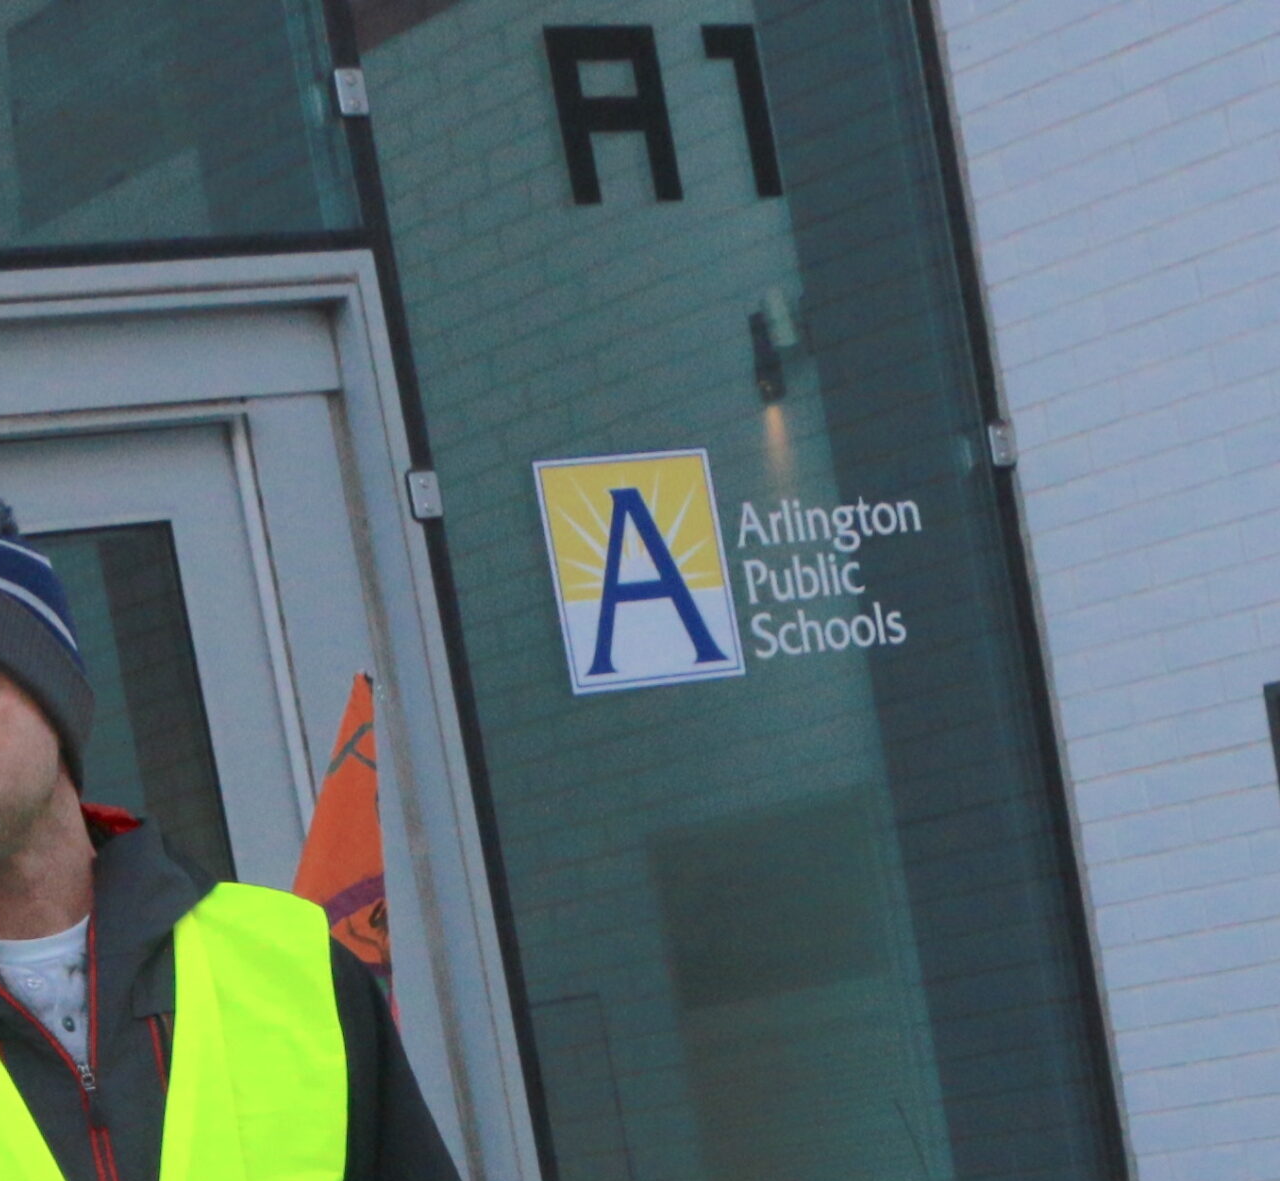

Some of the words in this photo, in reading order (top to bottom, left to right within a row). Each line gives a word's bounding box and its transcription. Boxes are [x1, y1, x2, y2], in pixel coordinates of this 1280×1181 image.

[543, 24, 783, 204] A1
[737, 496, 922, 551] Arlington
[585, 487, 730, 676] A
[743, 554, 866, 604] Public
[750, 602, 907, 658] Schools
